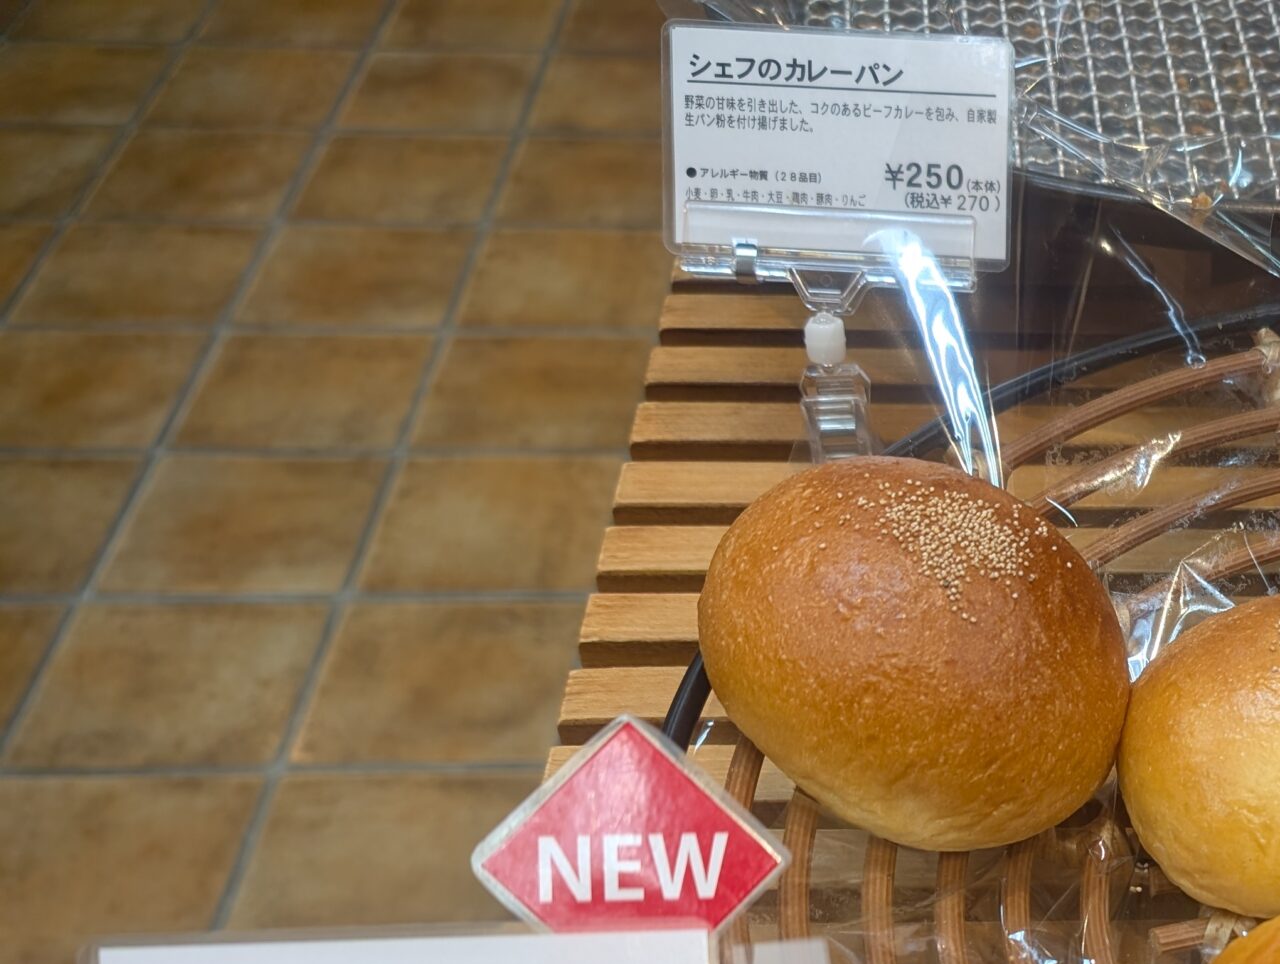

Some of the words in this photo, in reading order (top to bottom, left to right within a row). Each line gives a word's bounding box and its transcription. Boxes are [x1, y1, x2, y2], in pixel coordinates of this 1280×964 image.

[688, 53, 904, 87] シェフのカレーパン
[684, 115, 815, 133] 生パン粉を付け揚げました。
[884, 162, 965, 191] ¥250
[537, 831, 729, 905] NEW
